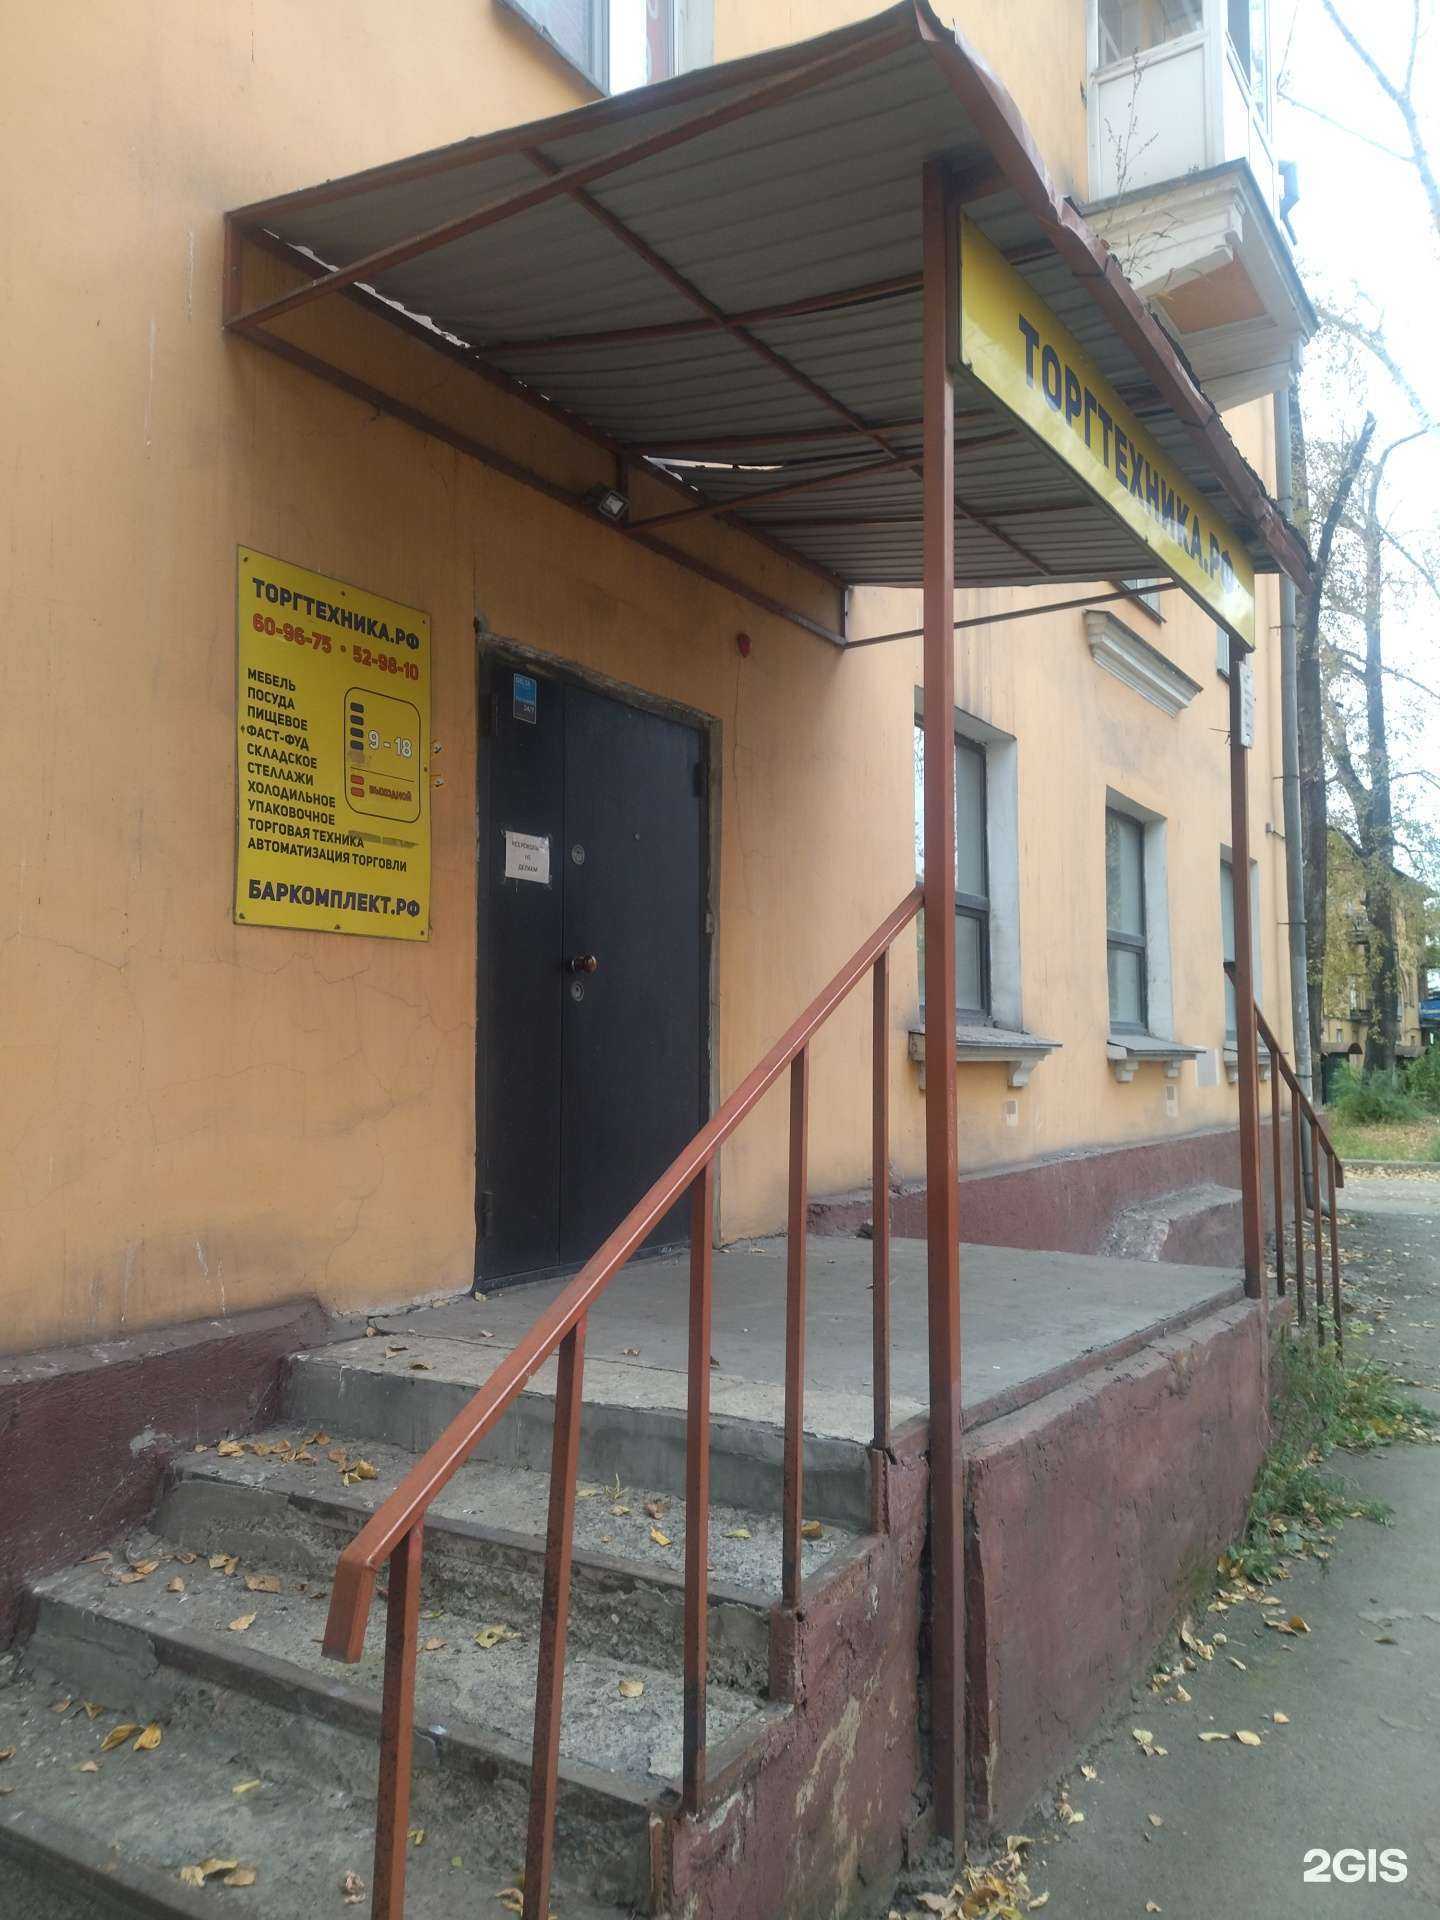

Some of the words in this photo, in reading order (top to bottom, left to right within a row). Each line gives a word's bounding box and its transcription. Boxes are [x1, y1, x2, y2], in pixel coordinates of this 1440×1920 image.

[1018, 313, 1234, 594] ТОРГТЕХНИКА.РФ
[252, 577, 420, 650] ТОРГТЕХНИКА.РФ
[247, 667, 296, 691] МЕБЕЛЬ
[247, 686, 295, 710] ПОСУДА
[247, 705, 308, 731] ПИЩЕВОЕ
[246, 724, 309, 751] ФАСТ-ФУД
[368, 730, 379, 750] 9
[395, 736, 412, 760] 18
[247, 743, 317, 769] СКЛАДСКОЕ
[247, 762, 314, 786] СТЕЛЛАЖИ
[247, 780, 336, 809] ХОЛОДИЛЬНОЕ
[247, 798, 335, 826] УПАКОВОЧНОЕ
[248, 817, 310, 839] ТОРГОВАЯ
[312, 828, 364, 849] ТЕХНИКА
[248, 837, 350, 864] АВТОМАТИЗАЦИЯ
[352, 853, 407, 872] ТОРГОВЛИ
[248, 879, 420, 917] БАРКОМПЛЕКТ.РФ
